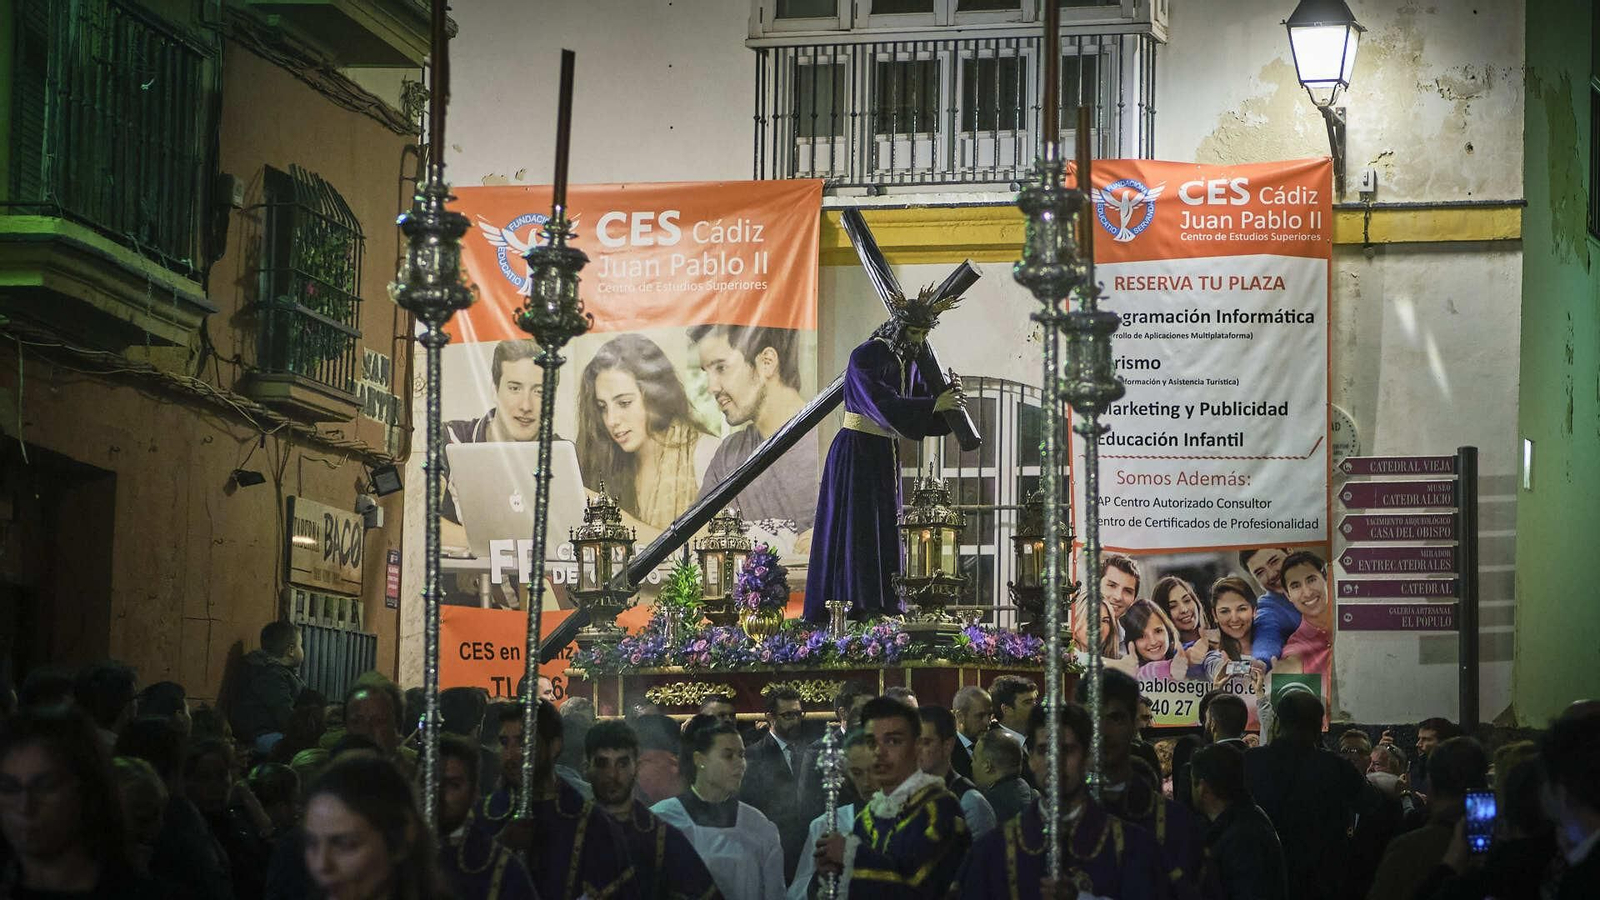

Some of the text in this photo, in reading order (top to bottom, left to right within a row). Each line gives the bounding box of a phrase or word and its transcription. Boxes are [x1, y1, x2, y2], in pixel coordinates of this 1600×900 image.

[1178, 177, 1318, 206] CES Cádiz
[509, 215, 550, 231] FUNDACI
[1180, 210, 1322, 230] Juan Pablo II
[596, 210, 764, 247] CES Cádiz
[1180, 232, 1321, 242] Centro de Estudios Superiores
[497, 247, 522, 286] EDUCATIO
[598, 251, 768, 279] Juan Pablo II
[598, 278, 768, 294] Centro de Estudios Superiores
[1114, 276, 1286, 291] RESERVA TU PLAZA
[1121, 308, 1315, 327] gramación Informática
[1112, 332, 1253, 341] rrollo de Aplicaciones Multiplataforma)
[1114, 355, 1161, 370] rismo
[1124, 377, 1161, 386] formación
[1168, 378, 1205, 387] Asistencia
[1206, 378, 1240, 388] Turística)
[1185, 404, 1195, 419] y
[1199, 401, 1289, 417] Publicidad
[1184, 432, 1244, 447] Infantil
[1369, 460, 1451, 473] CATEDRAL VIEJA
[1117, 470, 1252, 487] Somos Además:
[1098, 496, 1272, 509] AP Centro Autorizado Consultor
[1383, 494, 1451, 506] CATEDRALICIO
[1098, 516, 1319, 529] entro de Certificados de Profesionalidad
[1370, 527, 1451, 539] CASA DEL OBISPO
[1358, 560, 1452, 571] ENTRECATEDRALES
[1401, 583, 1452, 594] CATEDRAL
[1402, 616, 1414, 627] EL
[459, 642, 520, 660] CES en
[1174, 700, 1194, 716] 27
